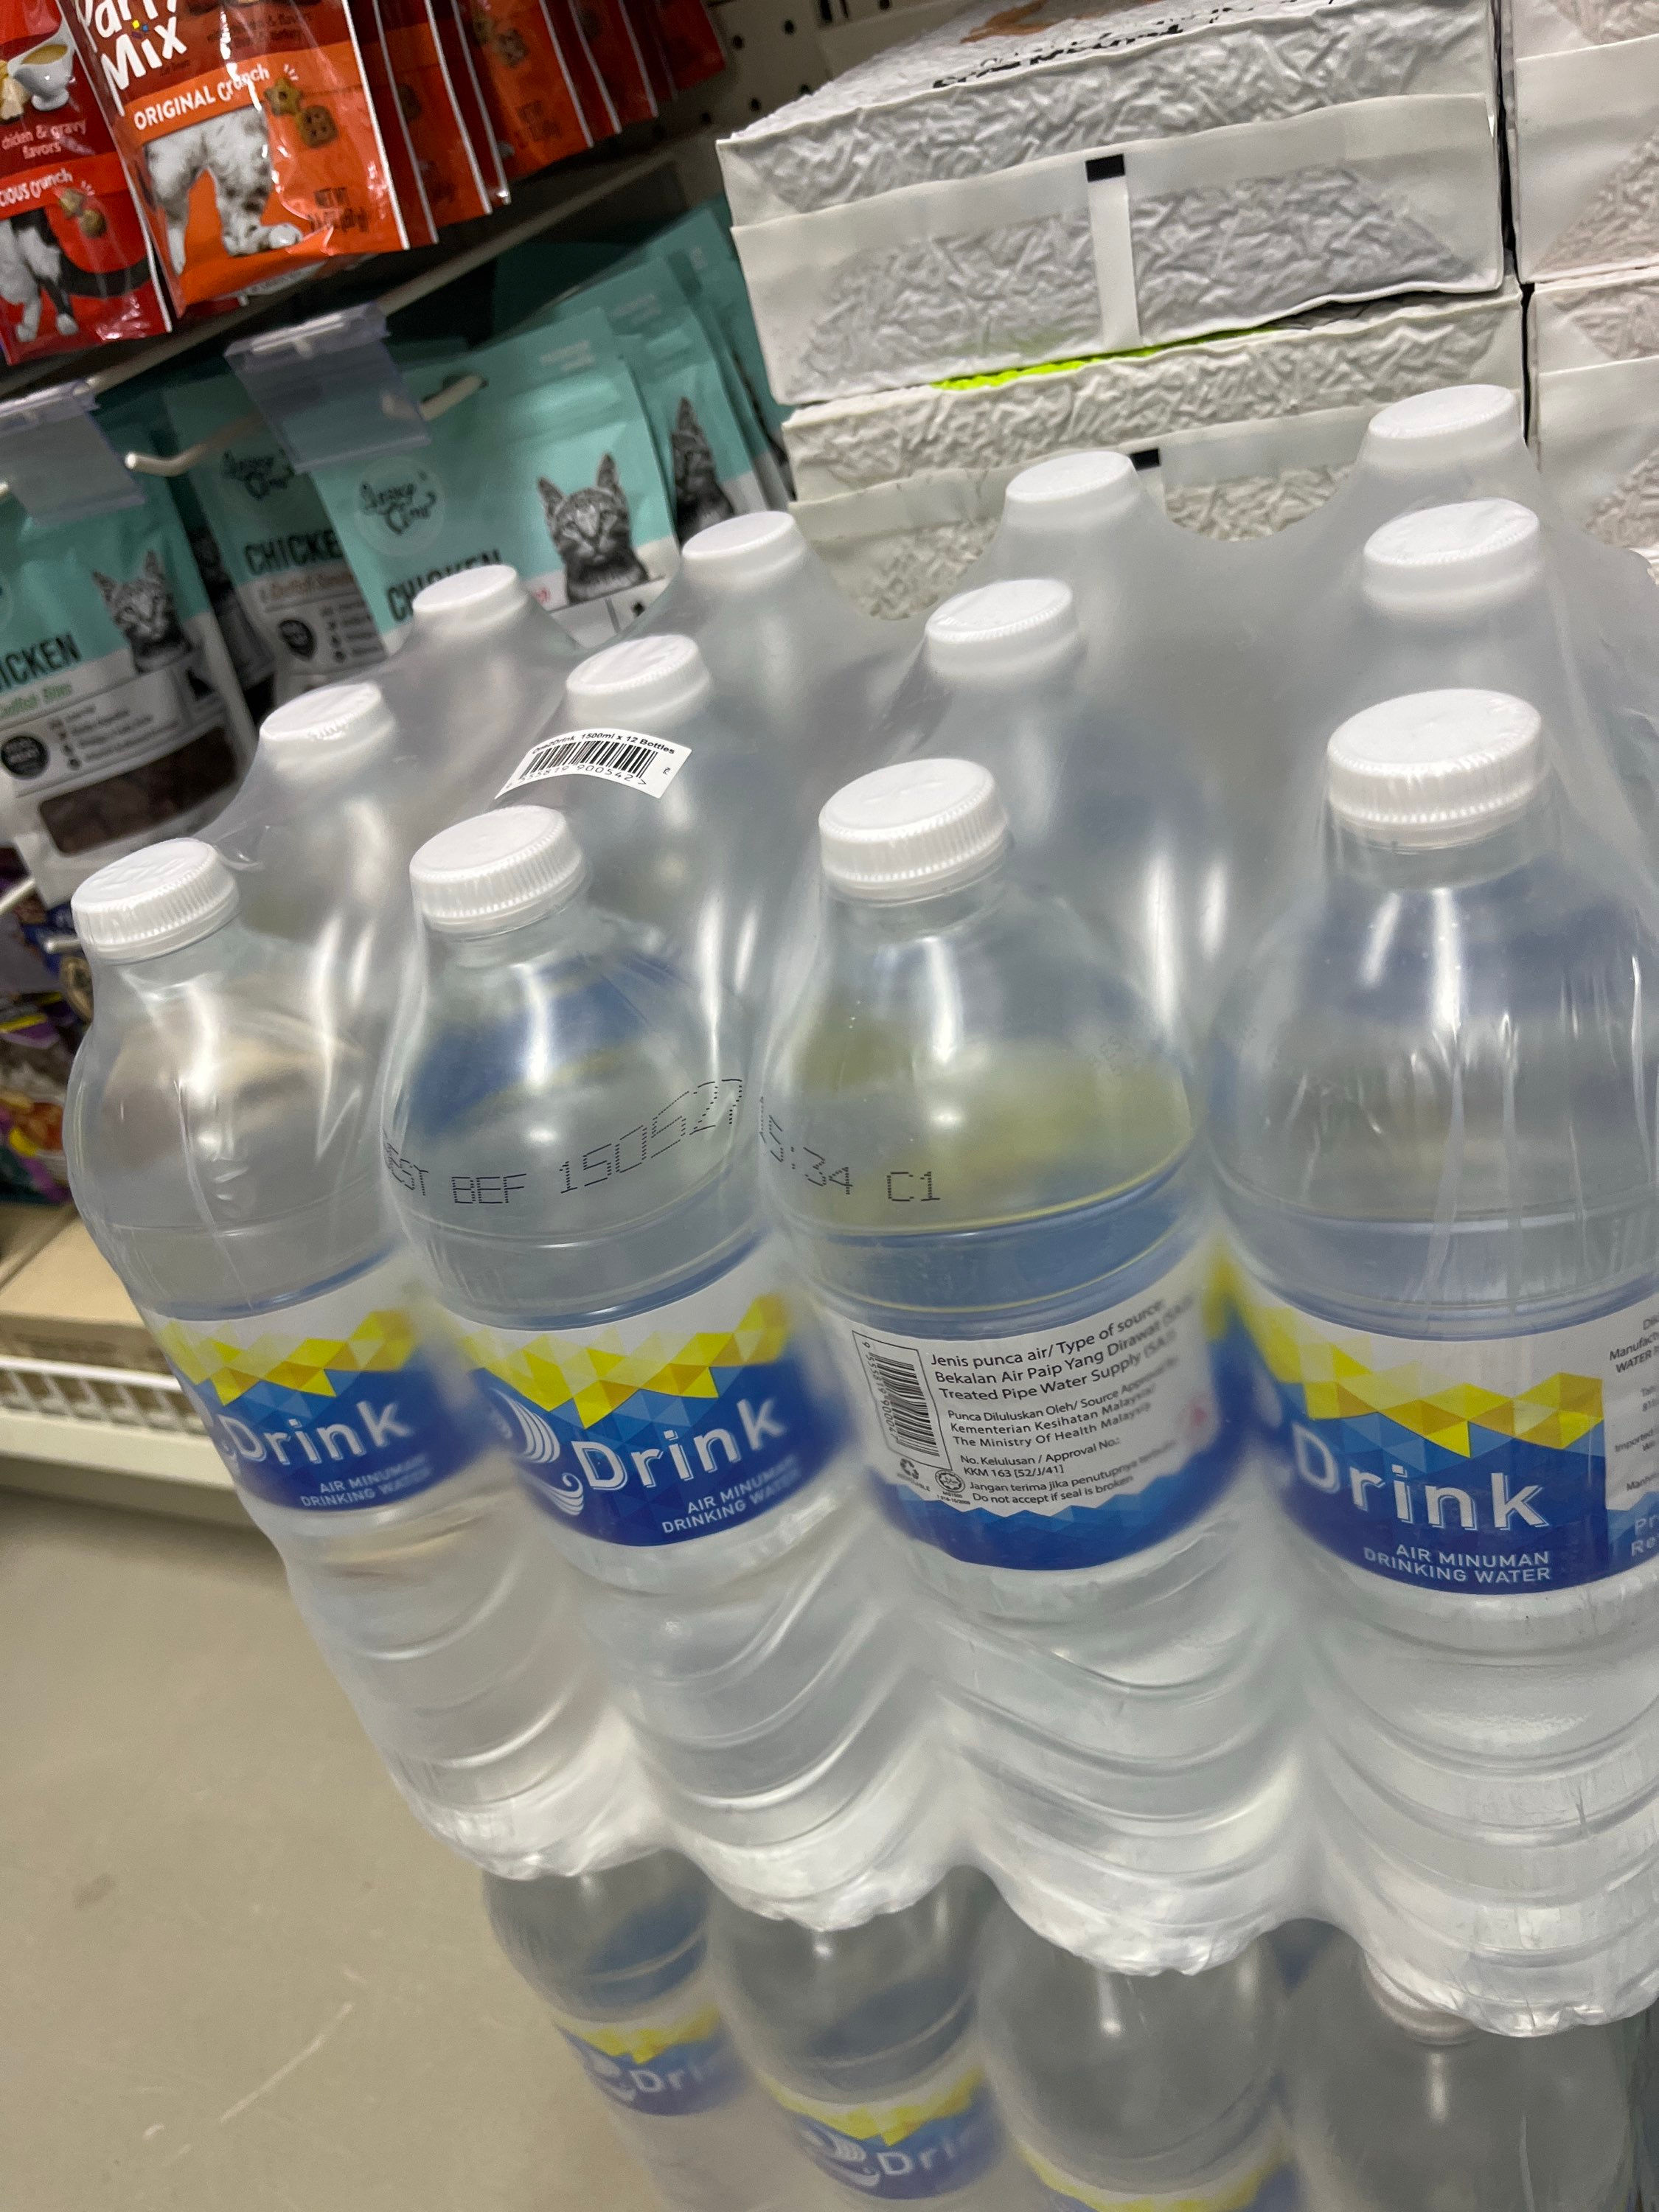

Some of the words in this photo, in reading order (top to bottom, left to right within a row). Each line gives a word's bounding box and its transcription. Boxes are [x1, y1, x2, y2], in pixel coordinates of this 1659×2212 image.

[75, 0, 176, 52] Par
[100, 16, 187, 116] Mix
[133, 86, 216, 131] ORIGINAL
[582, 732, 615, 741] 1500ml
[625, 736, 638, 744] 12
[639, 738, 675, 755] Bottles
[451, 1173, 527, 1204] BEF
[886, 1171, 941, 1203] C1
[931, 1354, 969, 1367] Jenis
[973, 1354, 1023, 1369] punca
[1027, 1344, 1054, 1361] air/
[1056, 1335, 1095, 1355] Type
[1099, 1323, 1115, 1340] of
[935, 1371, 997, 1384] Bekalan
[1001, 1370, 1023, 1382] Air
[1027, 1363, 1062, 1378] Paip
[1064, 1351, 1104, 1371] Yang
[939, 1388, 998, 1400] Treated
[1001, 1388, 1037, 1400] Pipe
[1040, 1376, 1088, 1394] Water
[1091, 1352, 1142, 1382] Supply
[947, 1410, 981, 1422] Punca
[984, 1409, 1044, 1422] Diluluskan
[1046, 1400, 1078, 1415] Oleh/
[1080, 1389, 1119, 1408] Source
[218, 1400, 414, 1465] Drink
[950, 1422, 1032, 1435] Kementerian
[1034, 1409, 1099, 1430] Kesihatan
[953, 1436, 976, 1447] The
[980, 1438, 1032, 1447] Ministry
[1035, 1432, 1051, 1444] Of
[1055, 1423, 1097, 1441] Health
[571, 1397, 788, 1492] Drink
[960, 1455, 979, 1465] No.
[981, 1455, 1035, 1466] Kelulusan
[1037, 1455, 1043, 1464] /
[1046, 1444, 1097, 1463] Approval
[320, 1480, 346, 1494] AIR
[963, 1466, 990, 1477] KKM
[991, 1469, 1012, 1478] 163
[970, 1482, 1009, 1492] Jangan
[1010, 1481, 1047, 1492] terima
[1048, 1477, 1069, 1491] jika
[1290, 1422, 1550, 1531] Drink
[300, 1487, 375, 1507] DRINKING
[688, 1496, 717, 1514] AIR
[973, 1492, 989, 1502] Do
[990, 1494, 1010, 1503] not
[1012, 1495, 1048, 1505] accept
[1051, 1492, 1059, 1501] if
[1060, 1488, 1082, 1500] seal
[1085, 1486, 1093, 1495] is
[662, 1500, 747, 1534] DRINKING
[1364, 1547, 1467, 1582] DRINKING
[1474, 1567, 1551, 1584] WATER
[1396, 1544, 1432, 1562] AIR
[1439, 1551, 1549, 1568] MINUMAN
